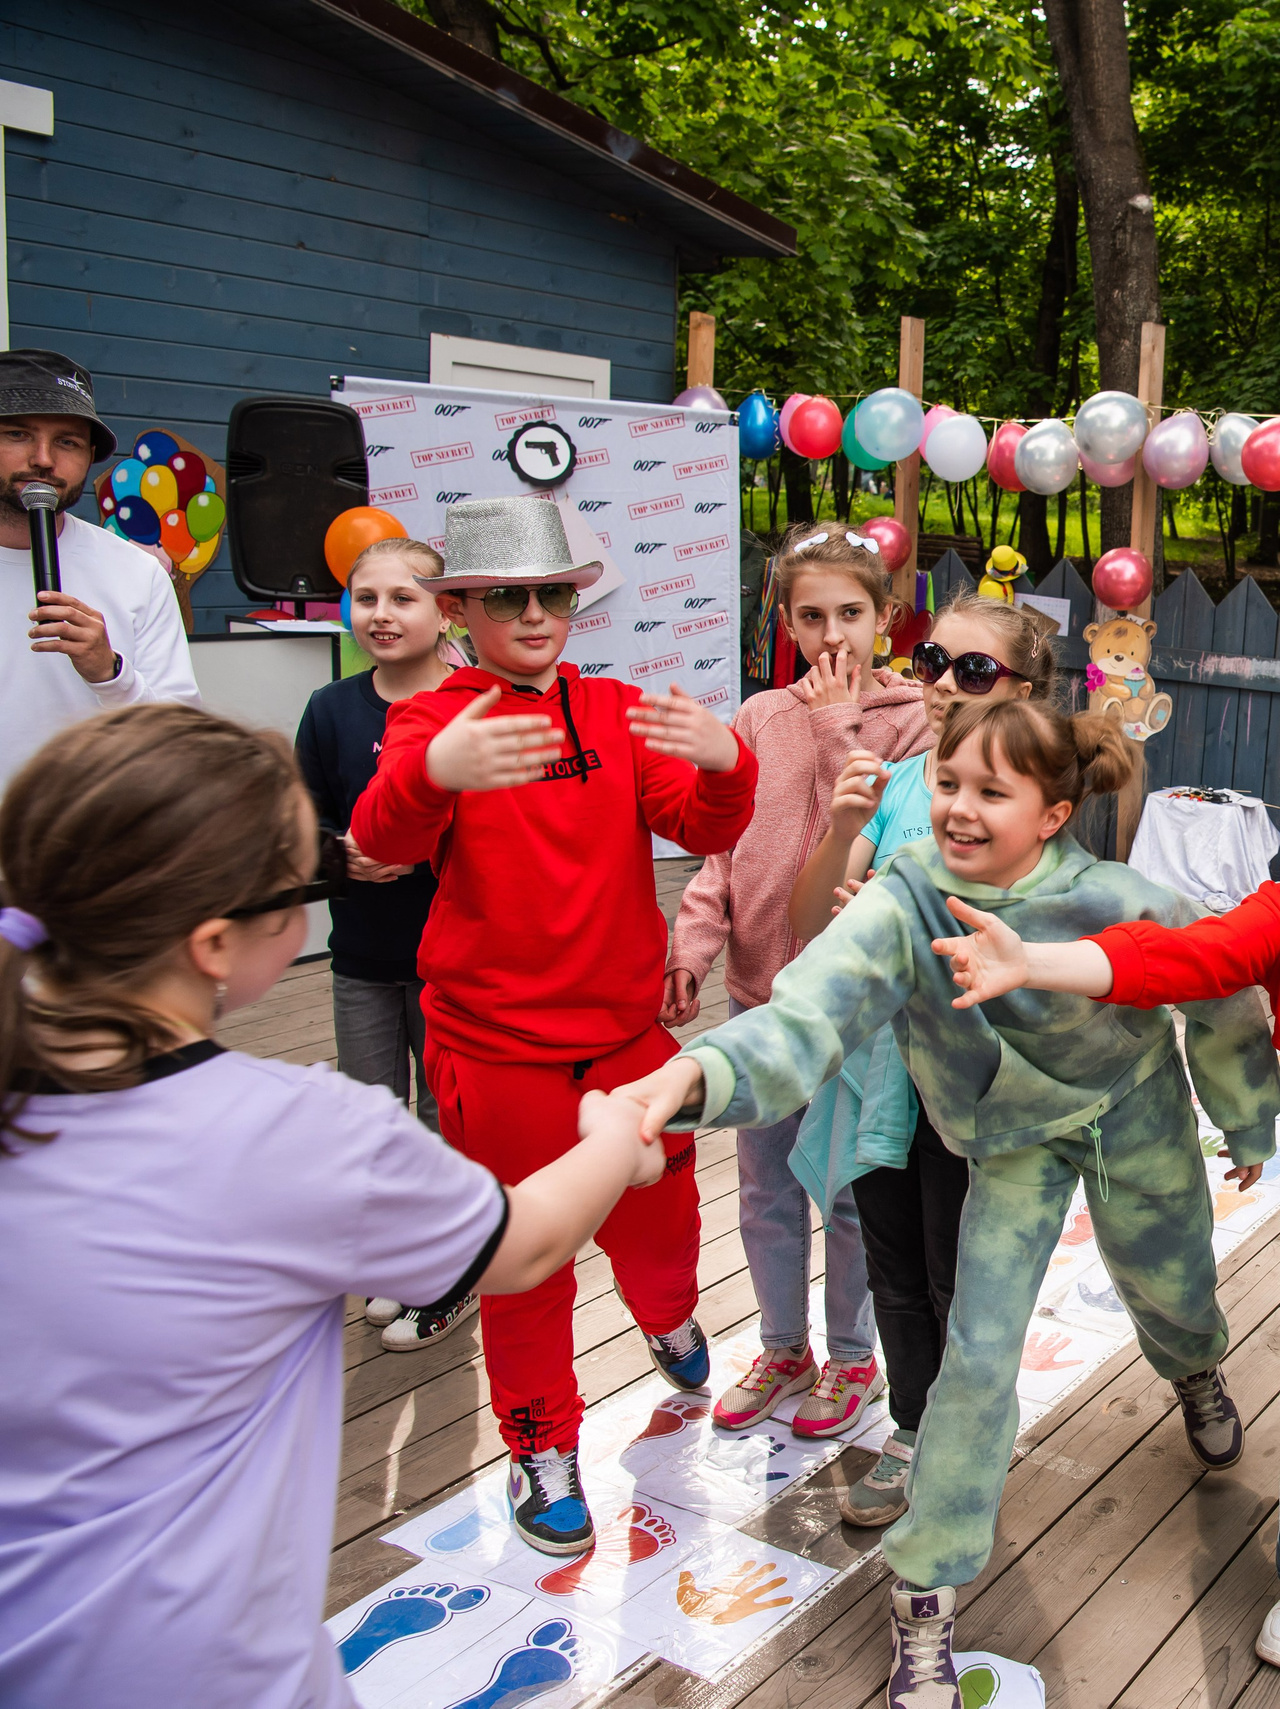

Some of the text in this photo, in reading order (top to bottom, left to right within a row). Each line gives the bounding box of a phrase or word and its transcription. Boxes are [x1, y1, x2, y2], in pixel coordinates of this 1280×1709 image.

[376, 400, 411, 412] SECRET
[434, 404, 463, 417] 007
[501, 409, 552, 426] TOP SECRET
[578, 416, 605, 429] 007
[632, 417, 682, 434] TOP SECRET
[695, 421, 720, 434] 007
[366, 444, 390, 457] 07
[416, 446, 469, 464] TOP SECRET
[492, 449, 510, 462] 00
[633, 460, 660, 472] 007
[678, 459, 725, 476] TOP SECRET
[436, 491, 464, 504] 007
[578, 500, 605, 512] 007
[633, 498, 680, 516] TOP SECRET
[694, 502, 720, 514] 007
[634, 542, 661, 554] 007
[678, 538, 726, 557] TOP SECRET
[644, 578, 692, 598] TOP SECRET
[684, 597, 711, 609] 007
[634, 620, 660, 633] 007
[678, 615, 725, 635] TOP SECRET
[580, 663, 607, 675] 007
[634, 656, 681, 676] TOP SECRET
[694, 658, 719, 671] 007
